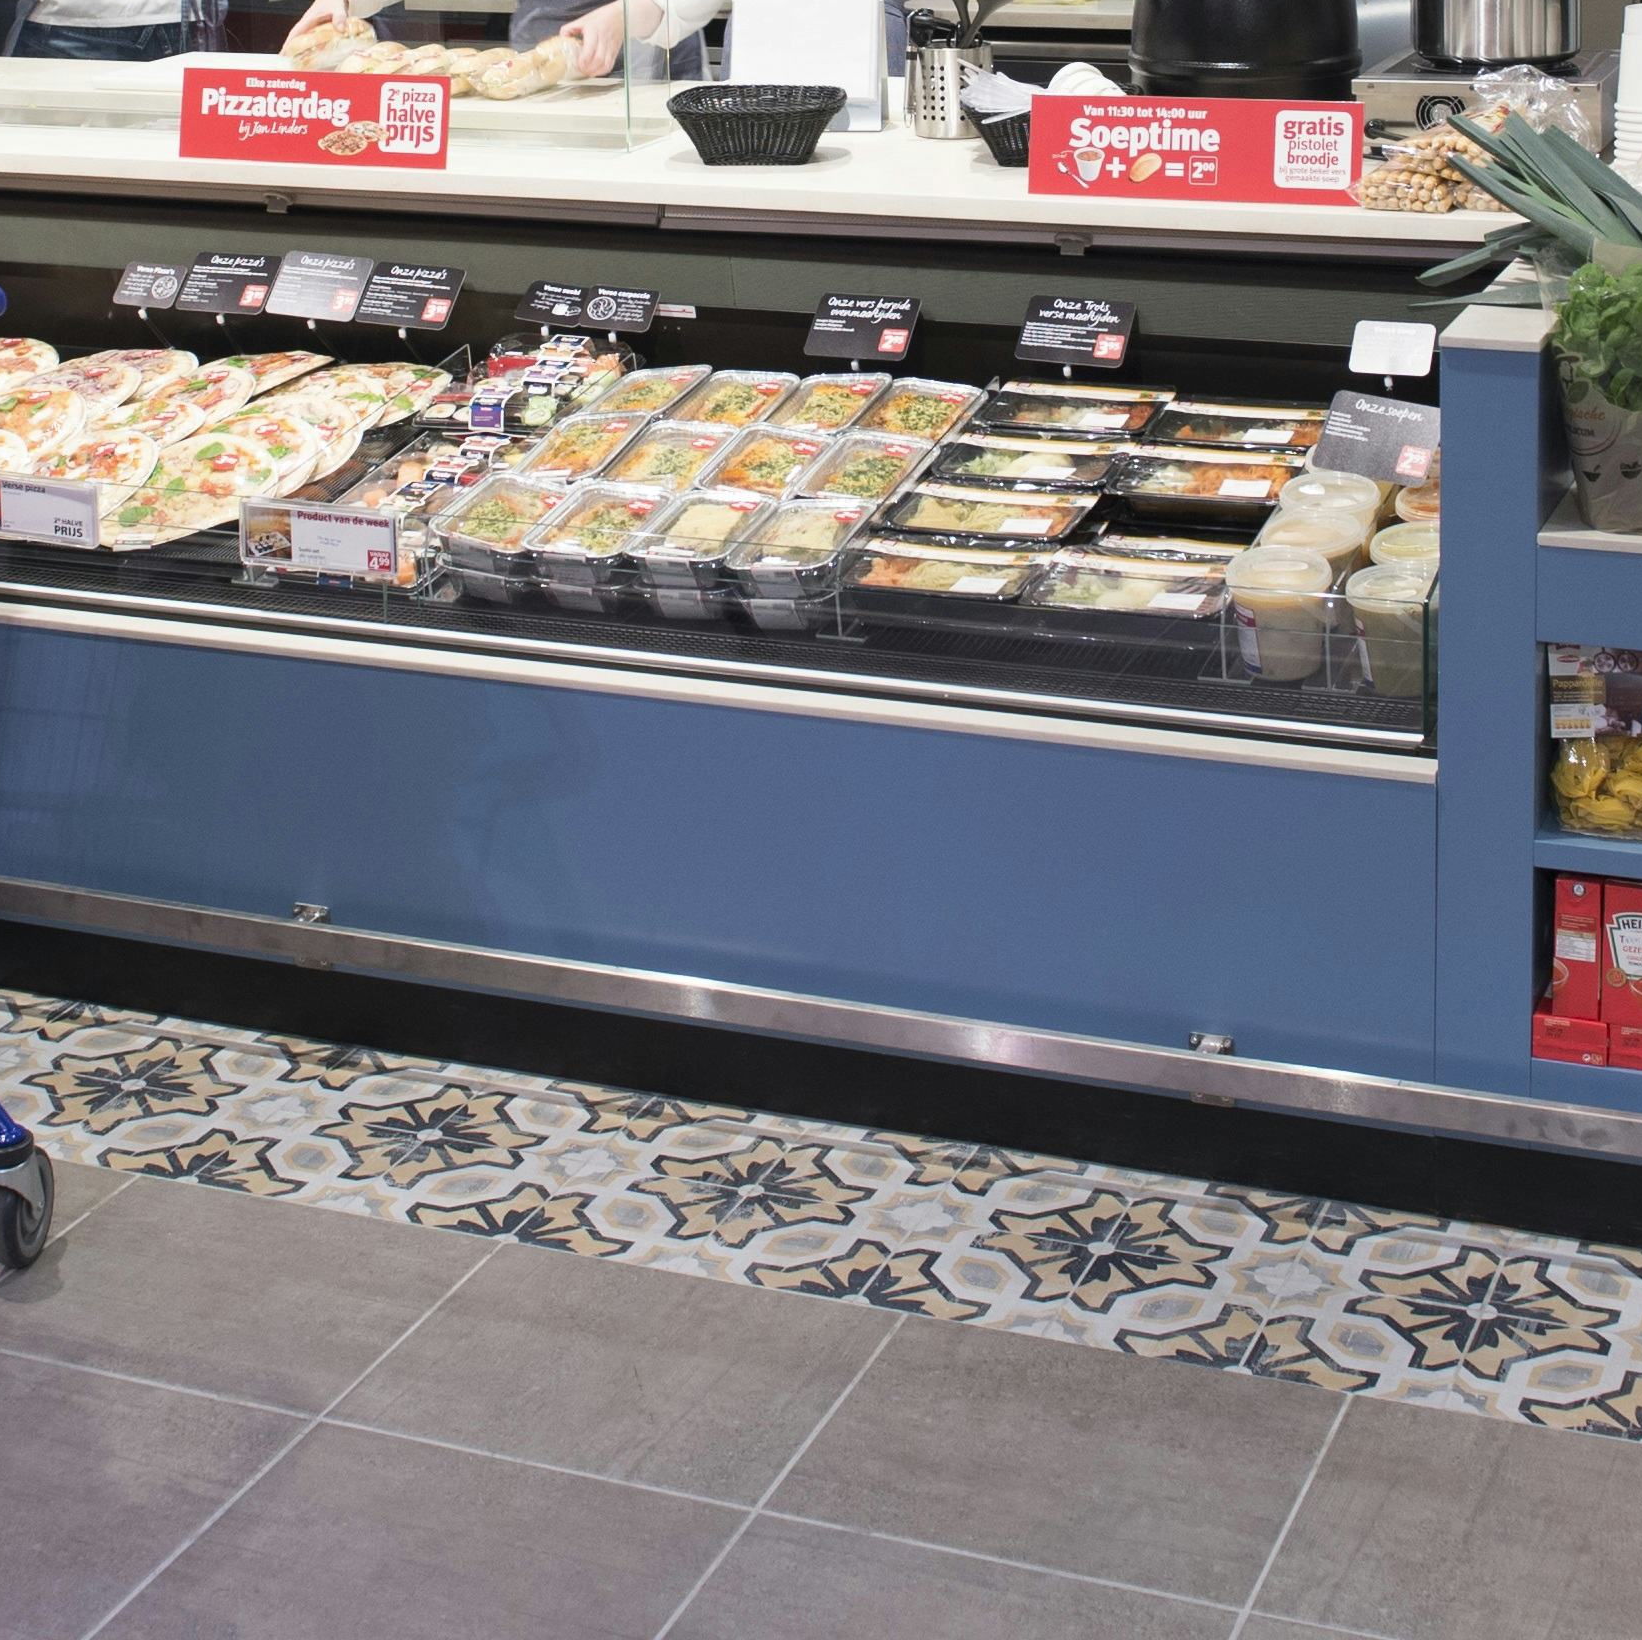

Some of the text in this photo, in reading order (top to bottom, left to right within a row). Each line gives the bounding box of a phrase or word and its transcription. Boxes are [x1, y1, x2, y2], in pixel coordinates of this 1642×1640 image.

[246, 77, 307, 92] Elke zaterdag
[201, 86, 351, 128] Pizzaterdag
[402, 90, 436, 109] pizza
[386, 103, 436, 124] halve
[1083, 105, 1208, 120] Van 11:30 tot 14:00 uur
[238, 119, 308, 141] bij Jan Linders
[385, 121, 435, 149] prijs
[1283, 116, 1345, 140] gratis
[1068, 117, 1221, 157] Soeptime
[1288, 138, 1338, 154] pistolet
[1287, 151, 1339, 168] broodje
[211, 254, 233, 265] Onze
[301, 255, 322, 266] Onze
[391, 265, 413, 277] Onze
[598, 288, 617, 296] Verse
[828, 296, 855, 307] Onze
[856, 300, 875, 309] vers
[1053, 299, 1110, 312] Onze Trots
[1039, 309, 1121, 328] verse maaltijden
[1355, 398, 1425, 424] Onze soepen
[25, 484, 46, 493] pizza
[297, 510, 390, 528] Product van de week
[54, 525, 83, 537] PRIJS
